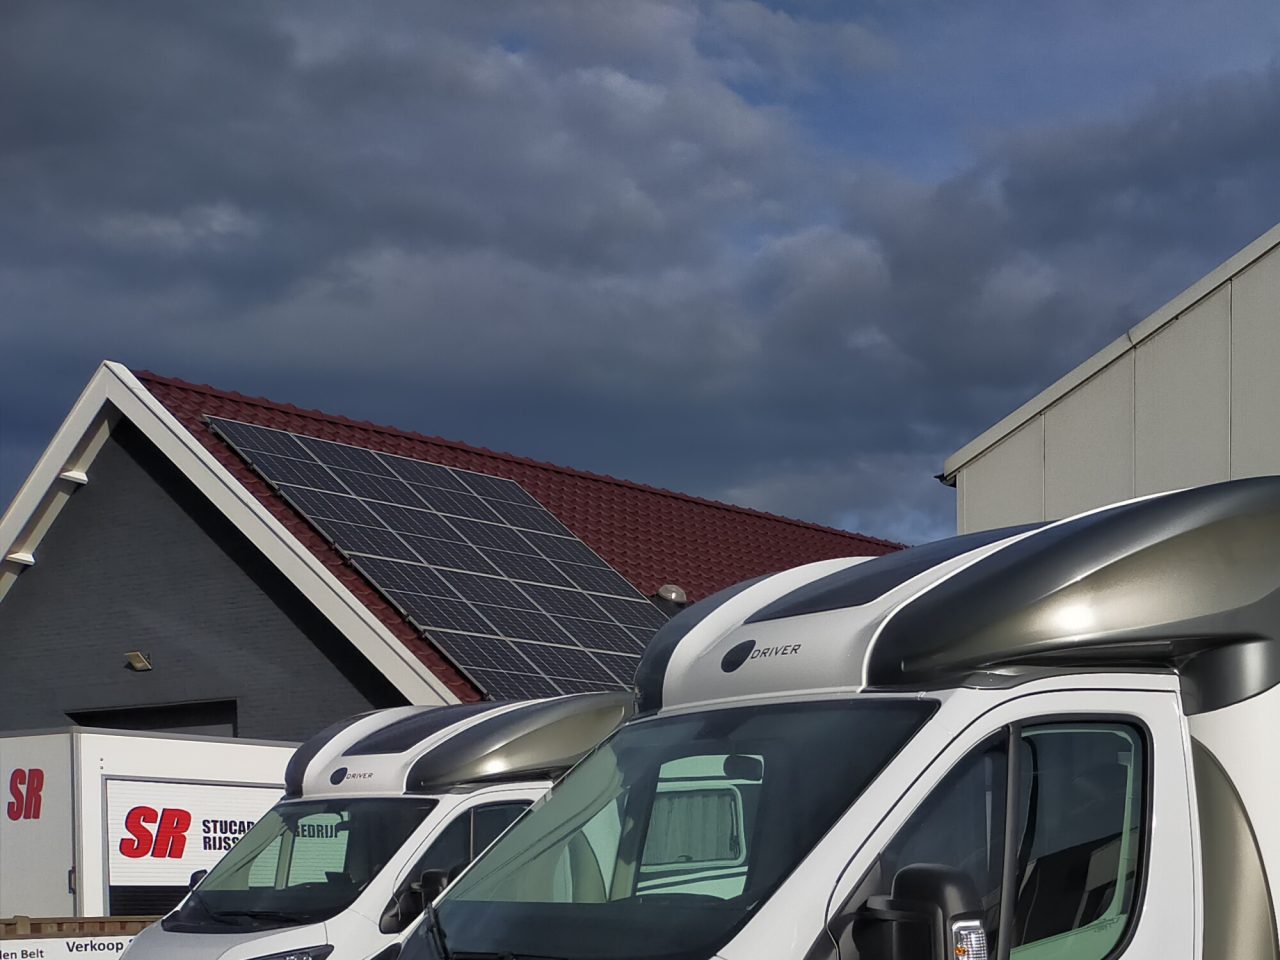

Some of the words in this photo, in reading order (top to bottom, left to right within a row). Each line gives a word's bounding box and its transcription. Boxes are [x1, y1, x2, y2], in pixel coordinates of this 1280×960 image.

[750, 644, 802, 659] DRIVER
[7, 768, 45, 821] SR
[119, 806, 192, 859] SR
[66, 940, 124, 953] Verkoop
